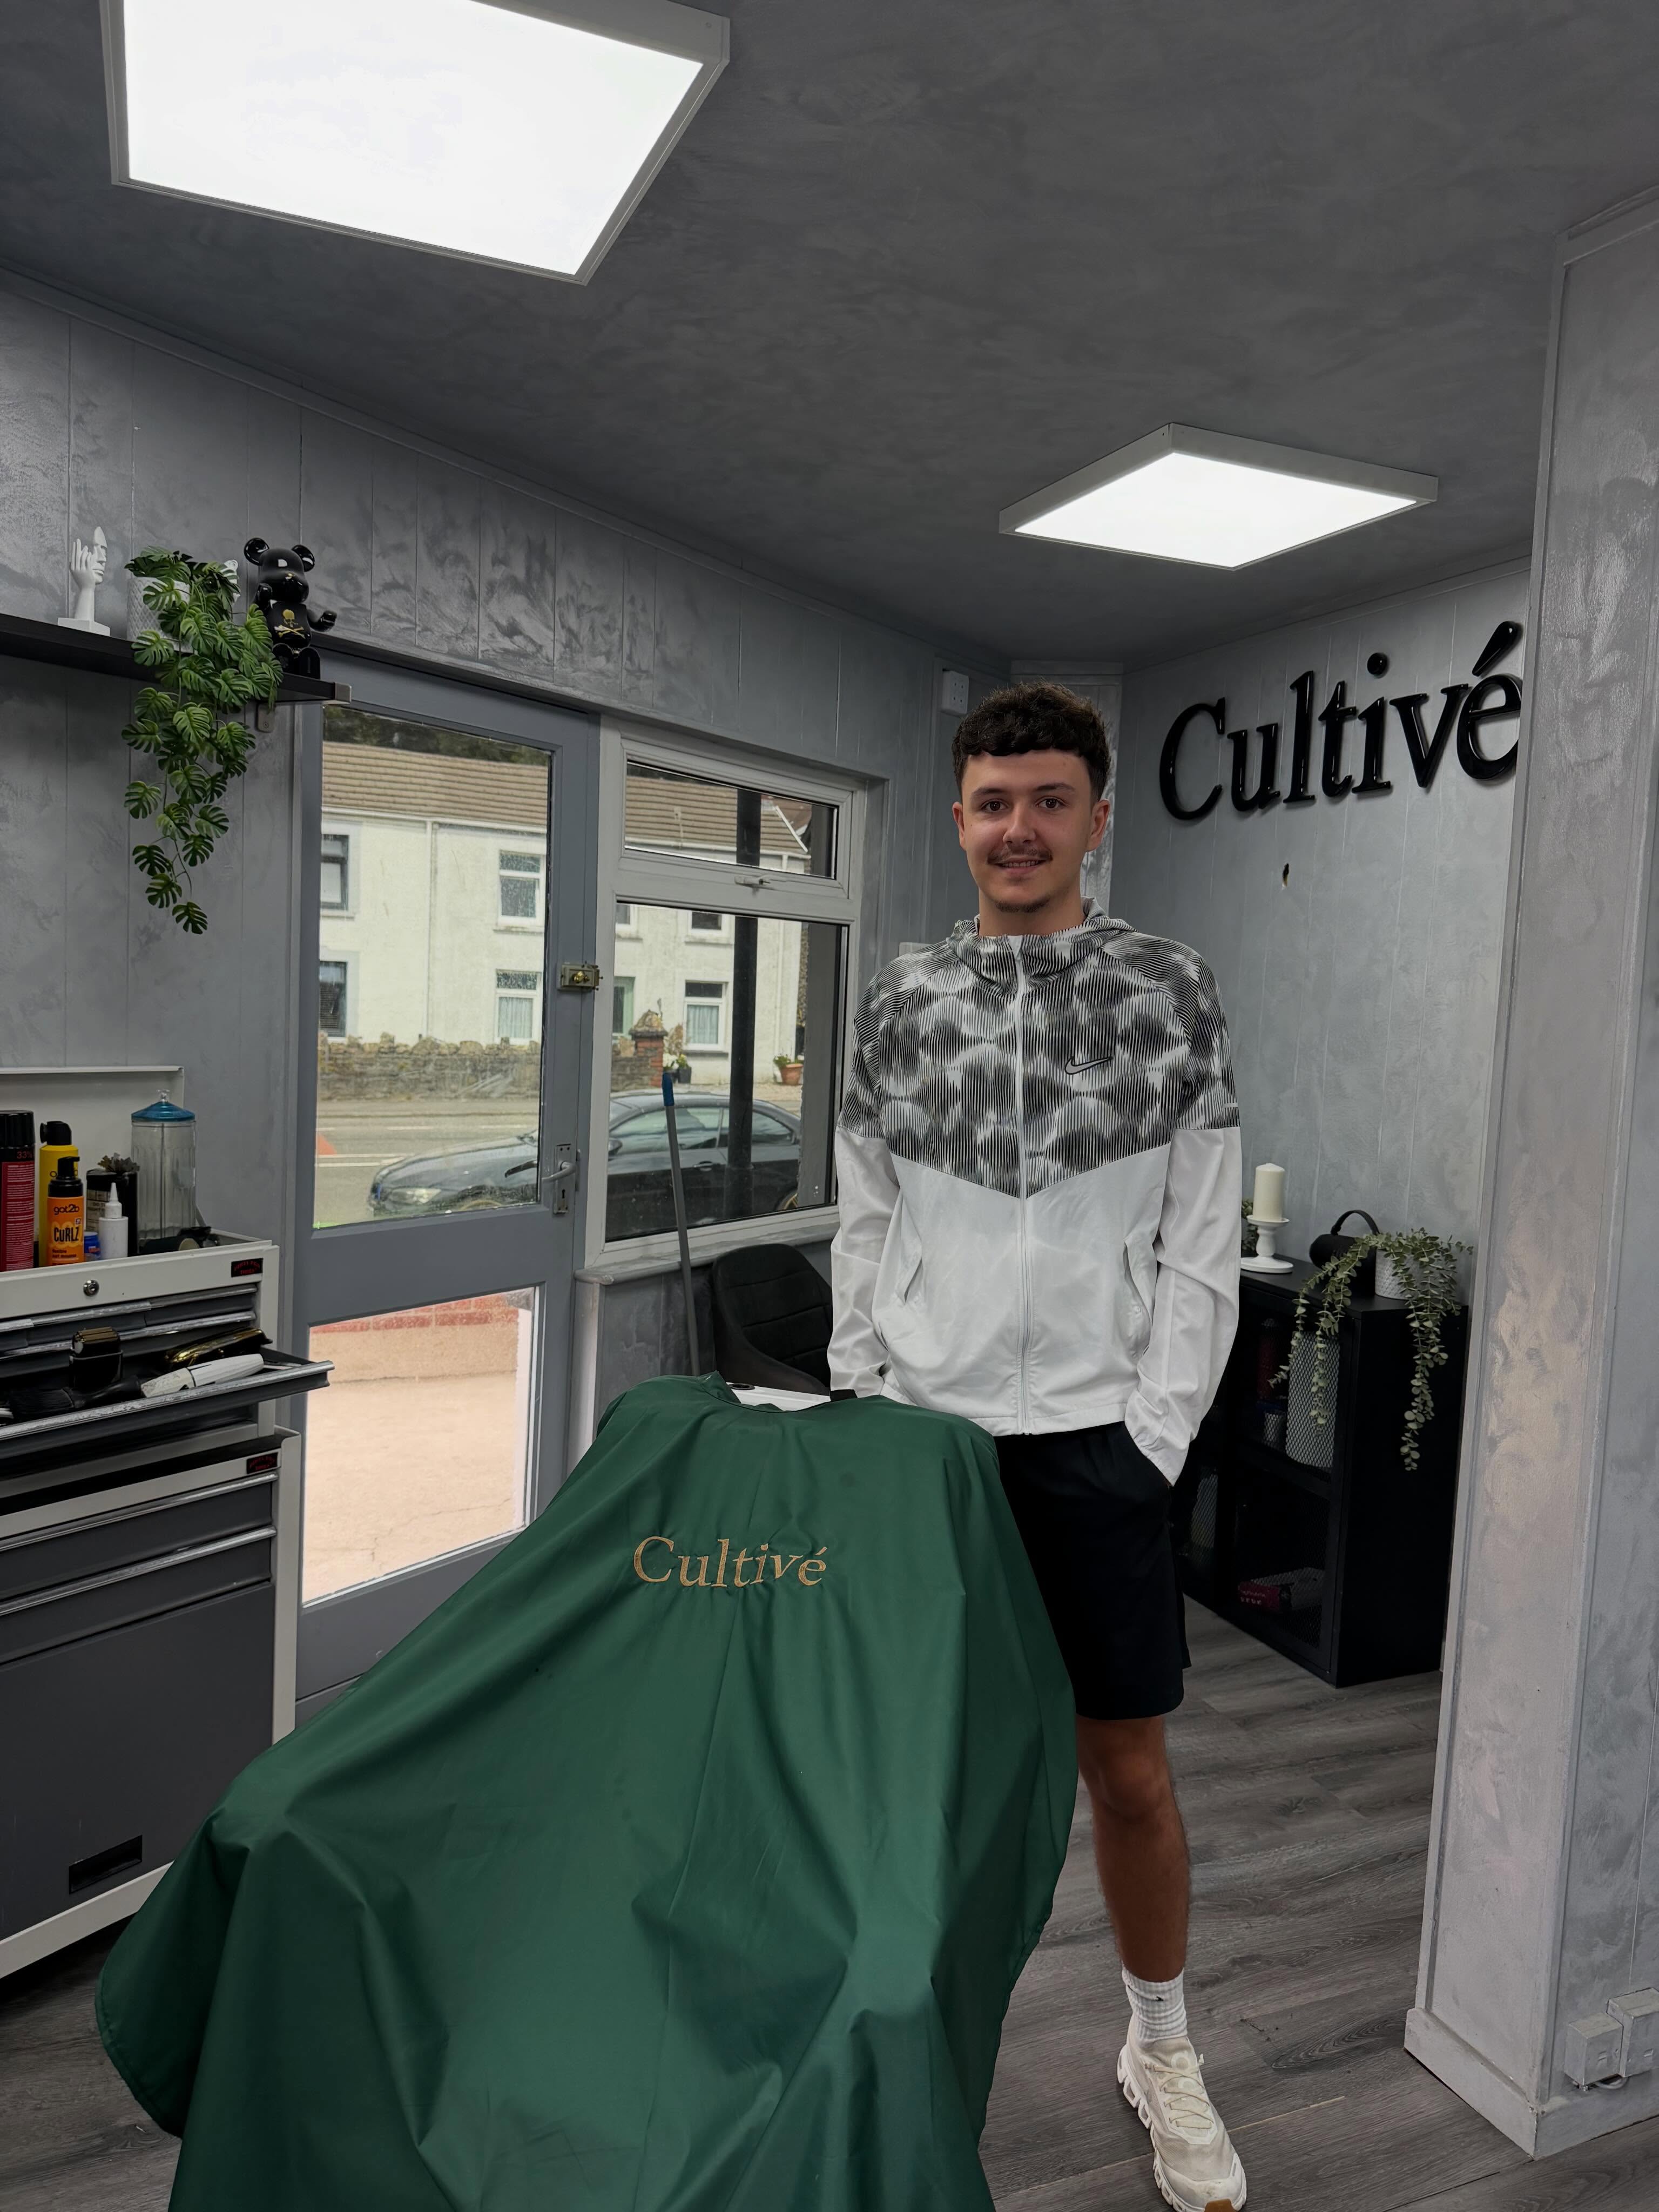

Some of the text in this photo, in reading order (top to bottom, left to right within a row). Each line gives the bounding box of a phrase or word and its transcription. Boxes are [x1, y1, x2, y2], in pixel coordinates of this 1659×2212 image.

[1159, 621, 1522, 820] Cultivé
[53, 1204, 80, 1215] got2b
[633, 1536, 827, 1587] Cultivé
